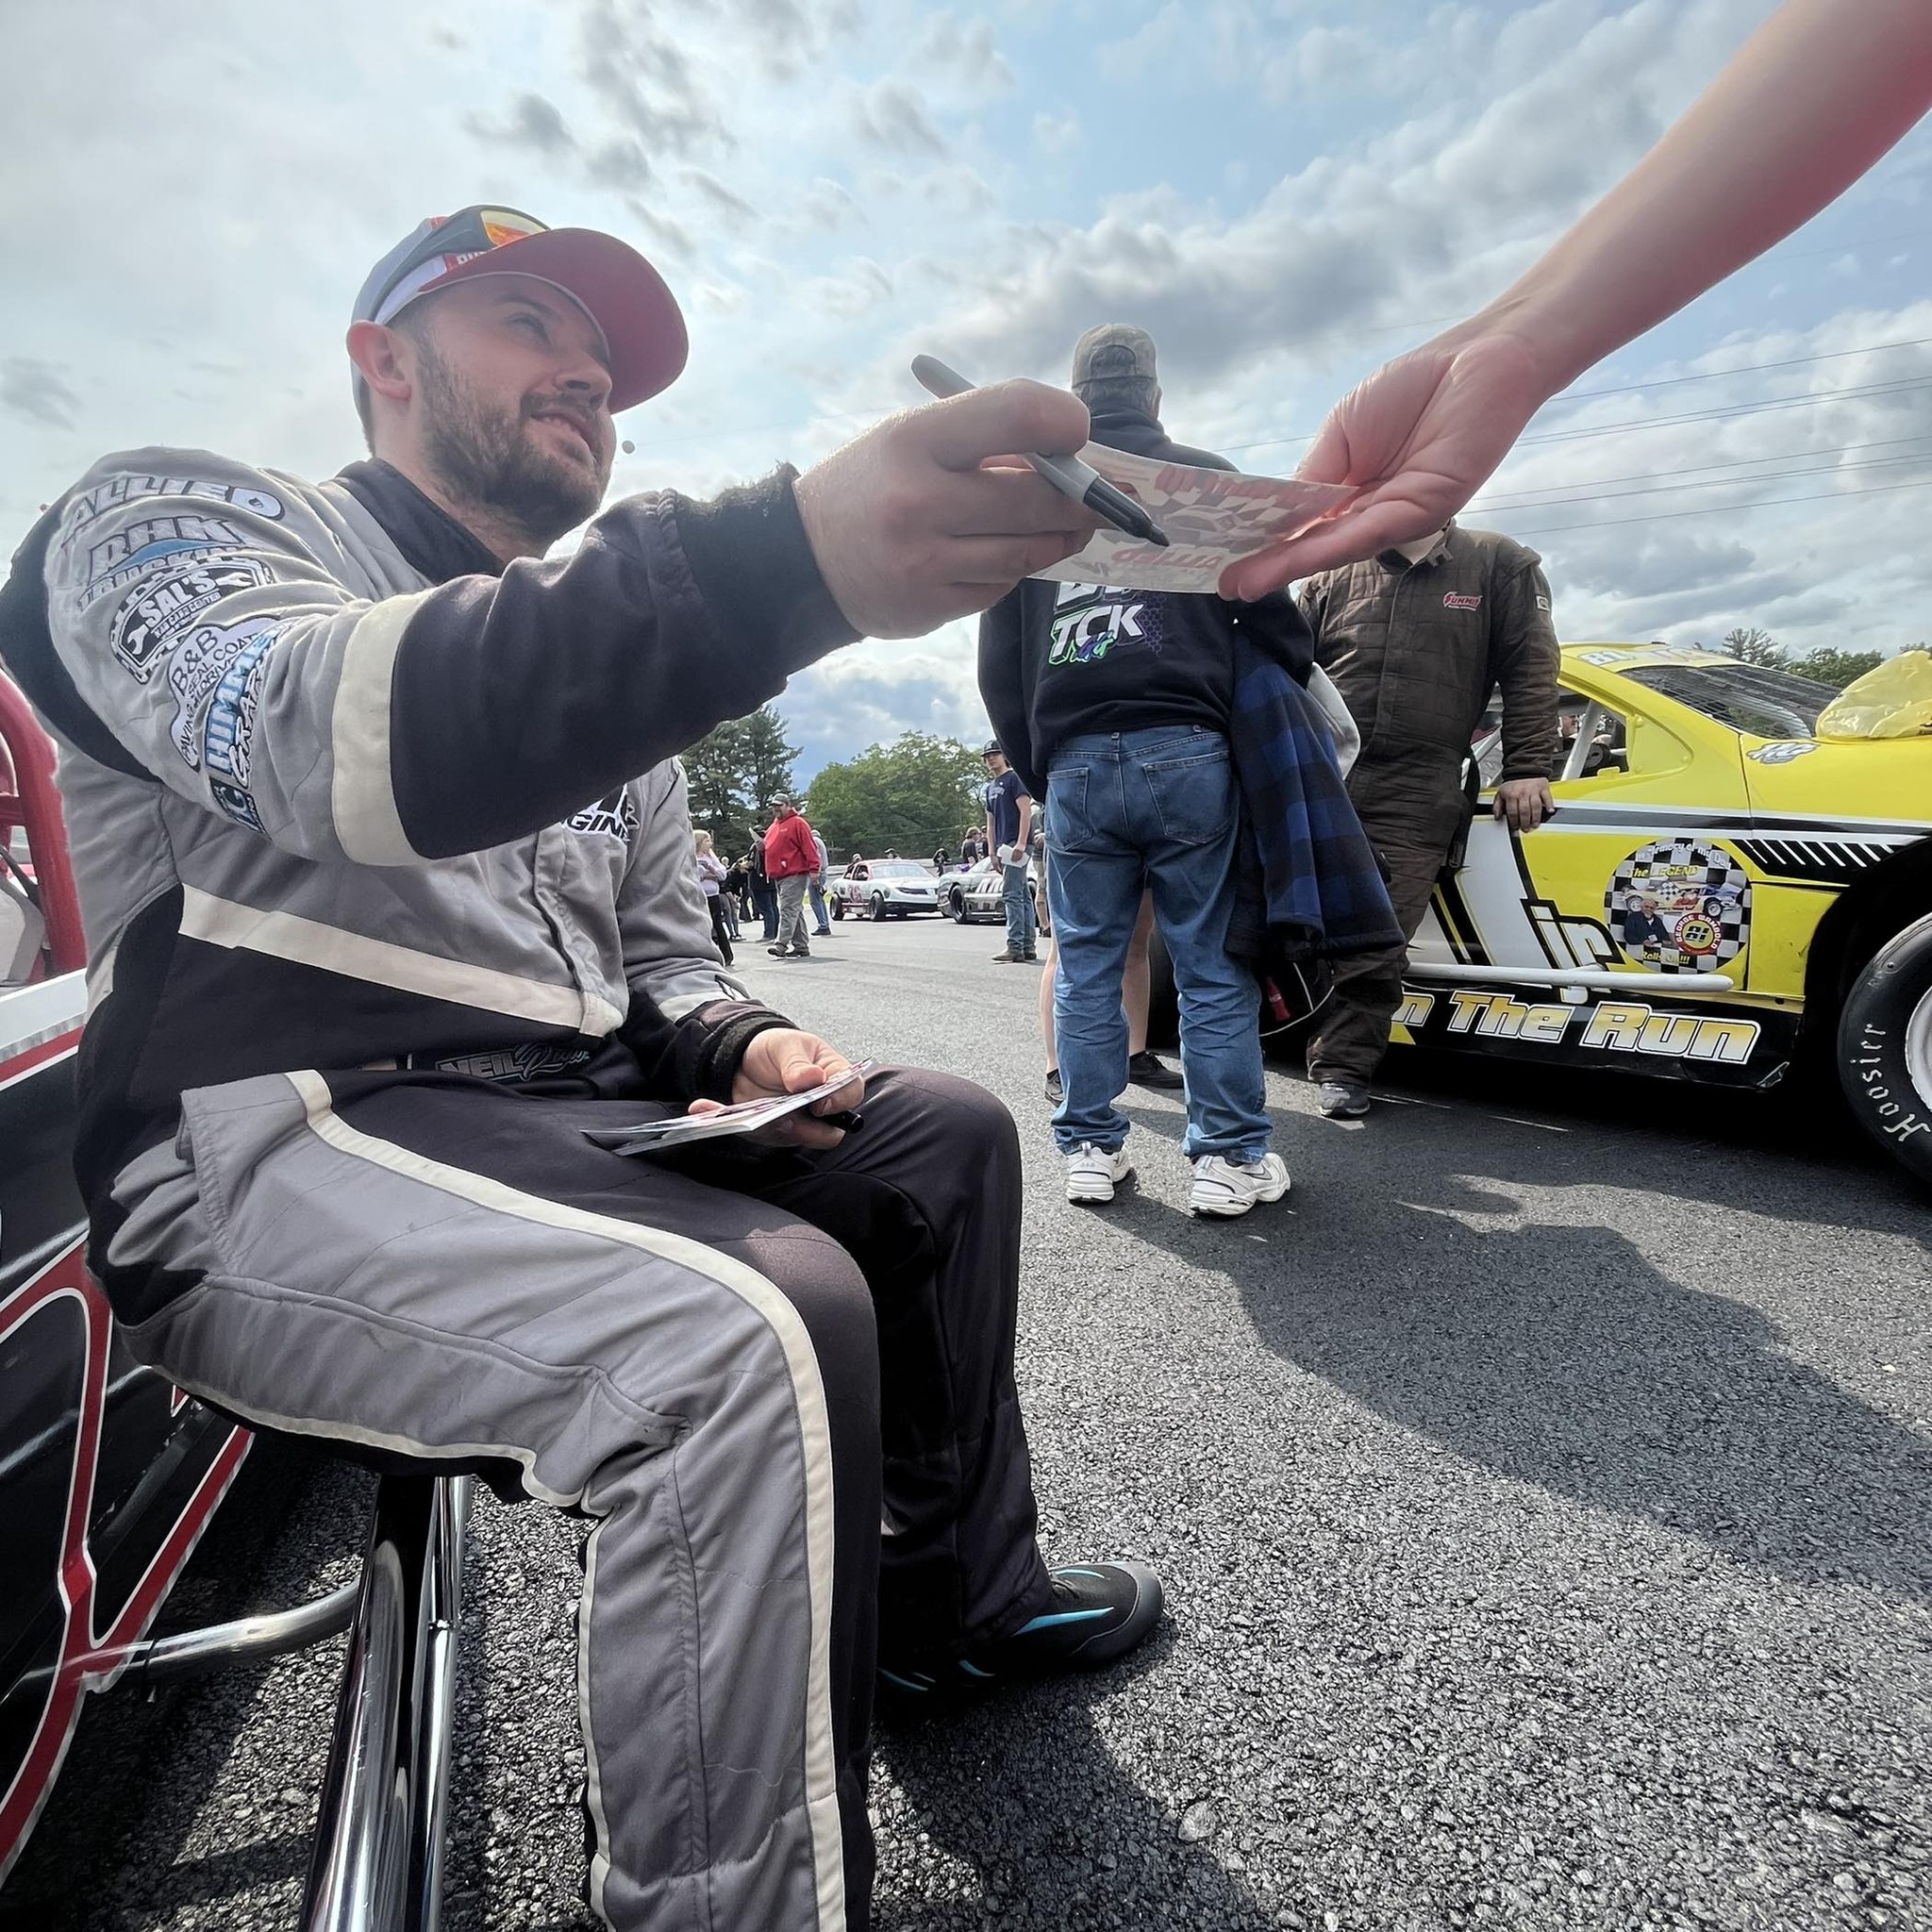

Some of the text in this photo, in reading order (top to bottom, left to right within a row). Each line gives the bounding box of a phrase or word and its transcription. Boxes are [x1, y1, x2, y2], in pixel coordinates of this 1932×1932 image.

[61, 475, 285, 548] ALLIED
[77, 544, 251, 611] TRUCKIN
[139, 570, 217, 627] SAL'S
[171, 629, 218, 696] B&B
[205, 625, 282, 775] HIMME
[1447, 991, 1576, 1043] The
[1578, 1000, 1761, 1065] Run
[1849, 1023, 1931, 1142] Hoosier
